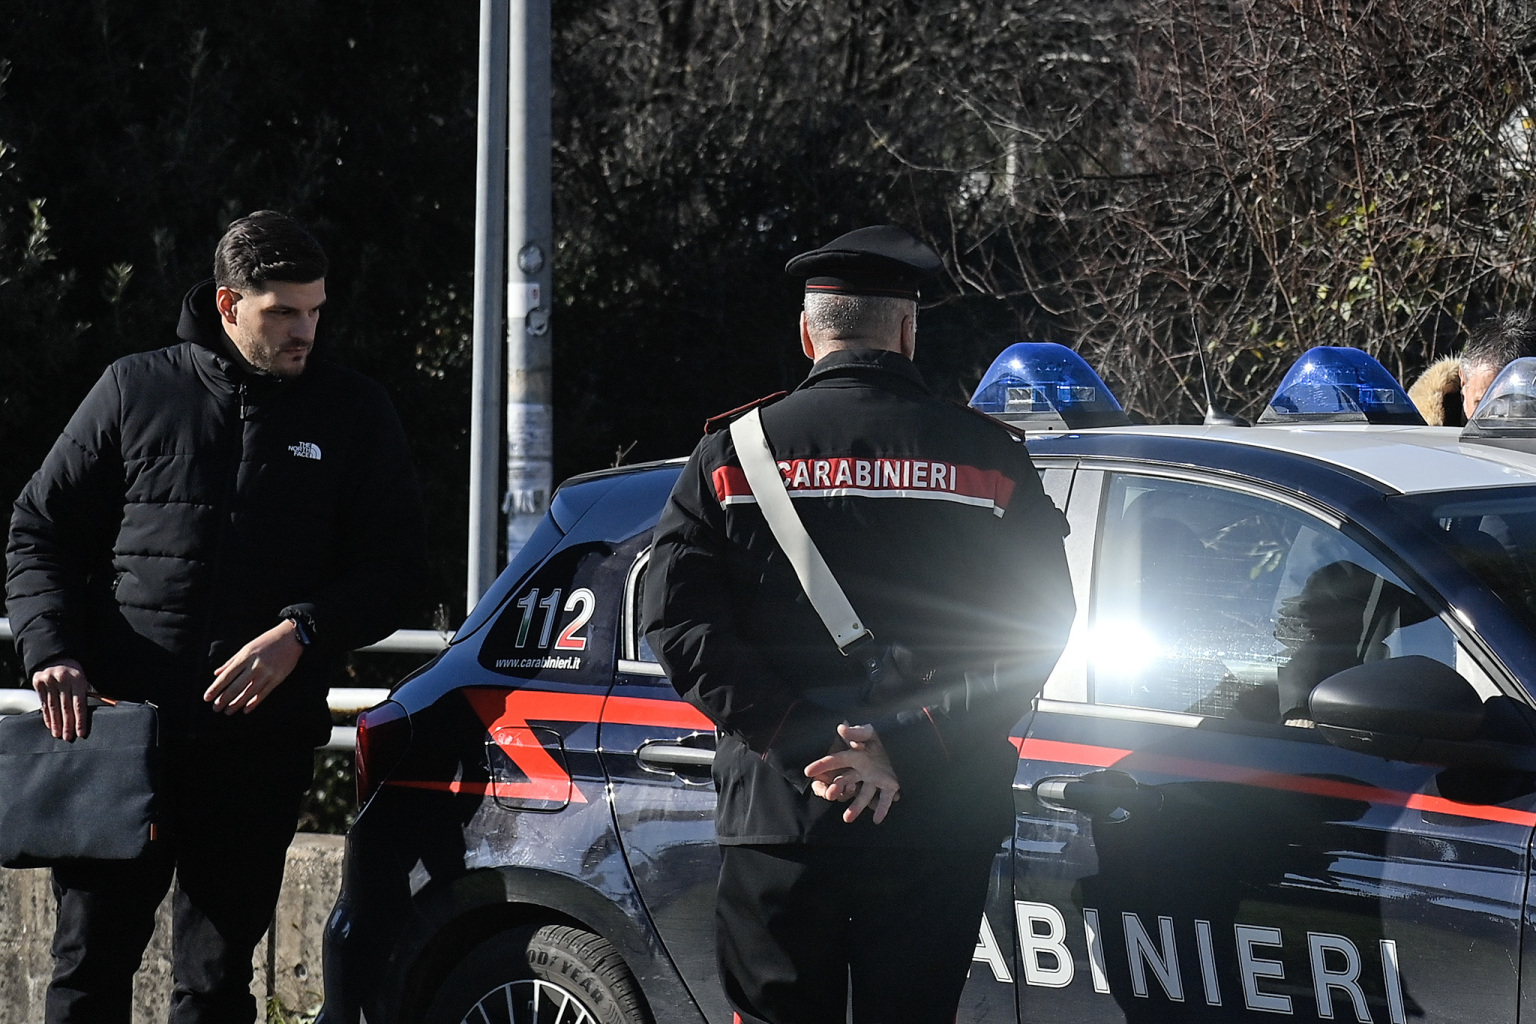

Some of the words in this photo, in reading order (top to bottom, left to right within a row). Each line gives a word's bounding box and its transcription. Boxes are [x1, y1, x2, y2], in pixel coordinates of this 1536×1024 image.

[287, 445, 311, 454] NORTH
[293, 451, 312, 459] FACE
[776, 460, 957, 492] CARABINIERI
[515, 587, 596, 651] 112
[495, 656, 581, 670] www.carabinieri.it
